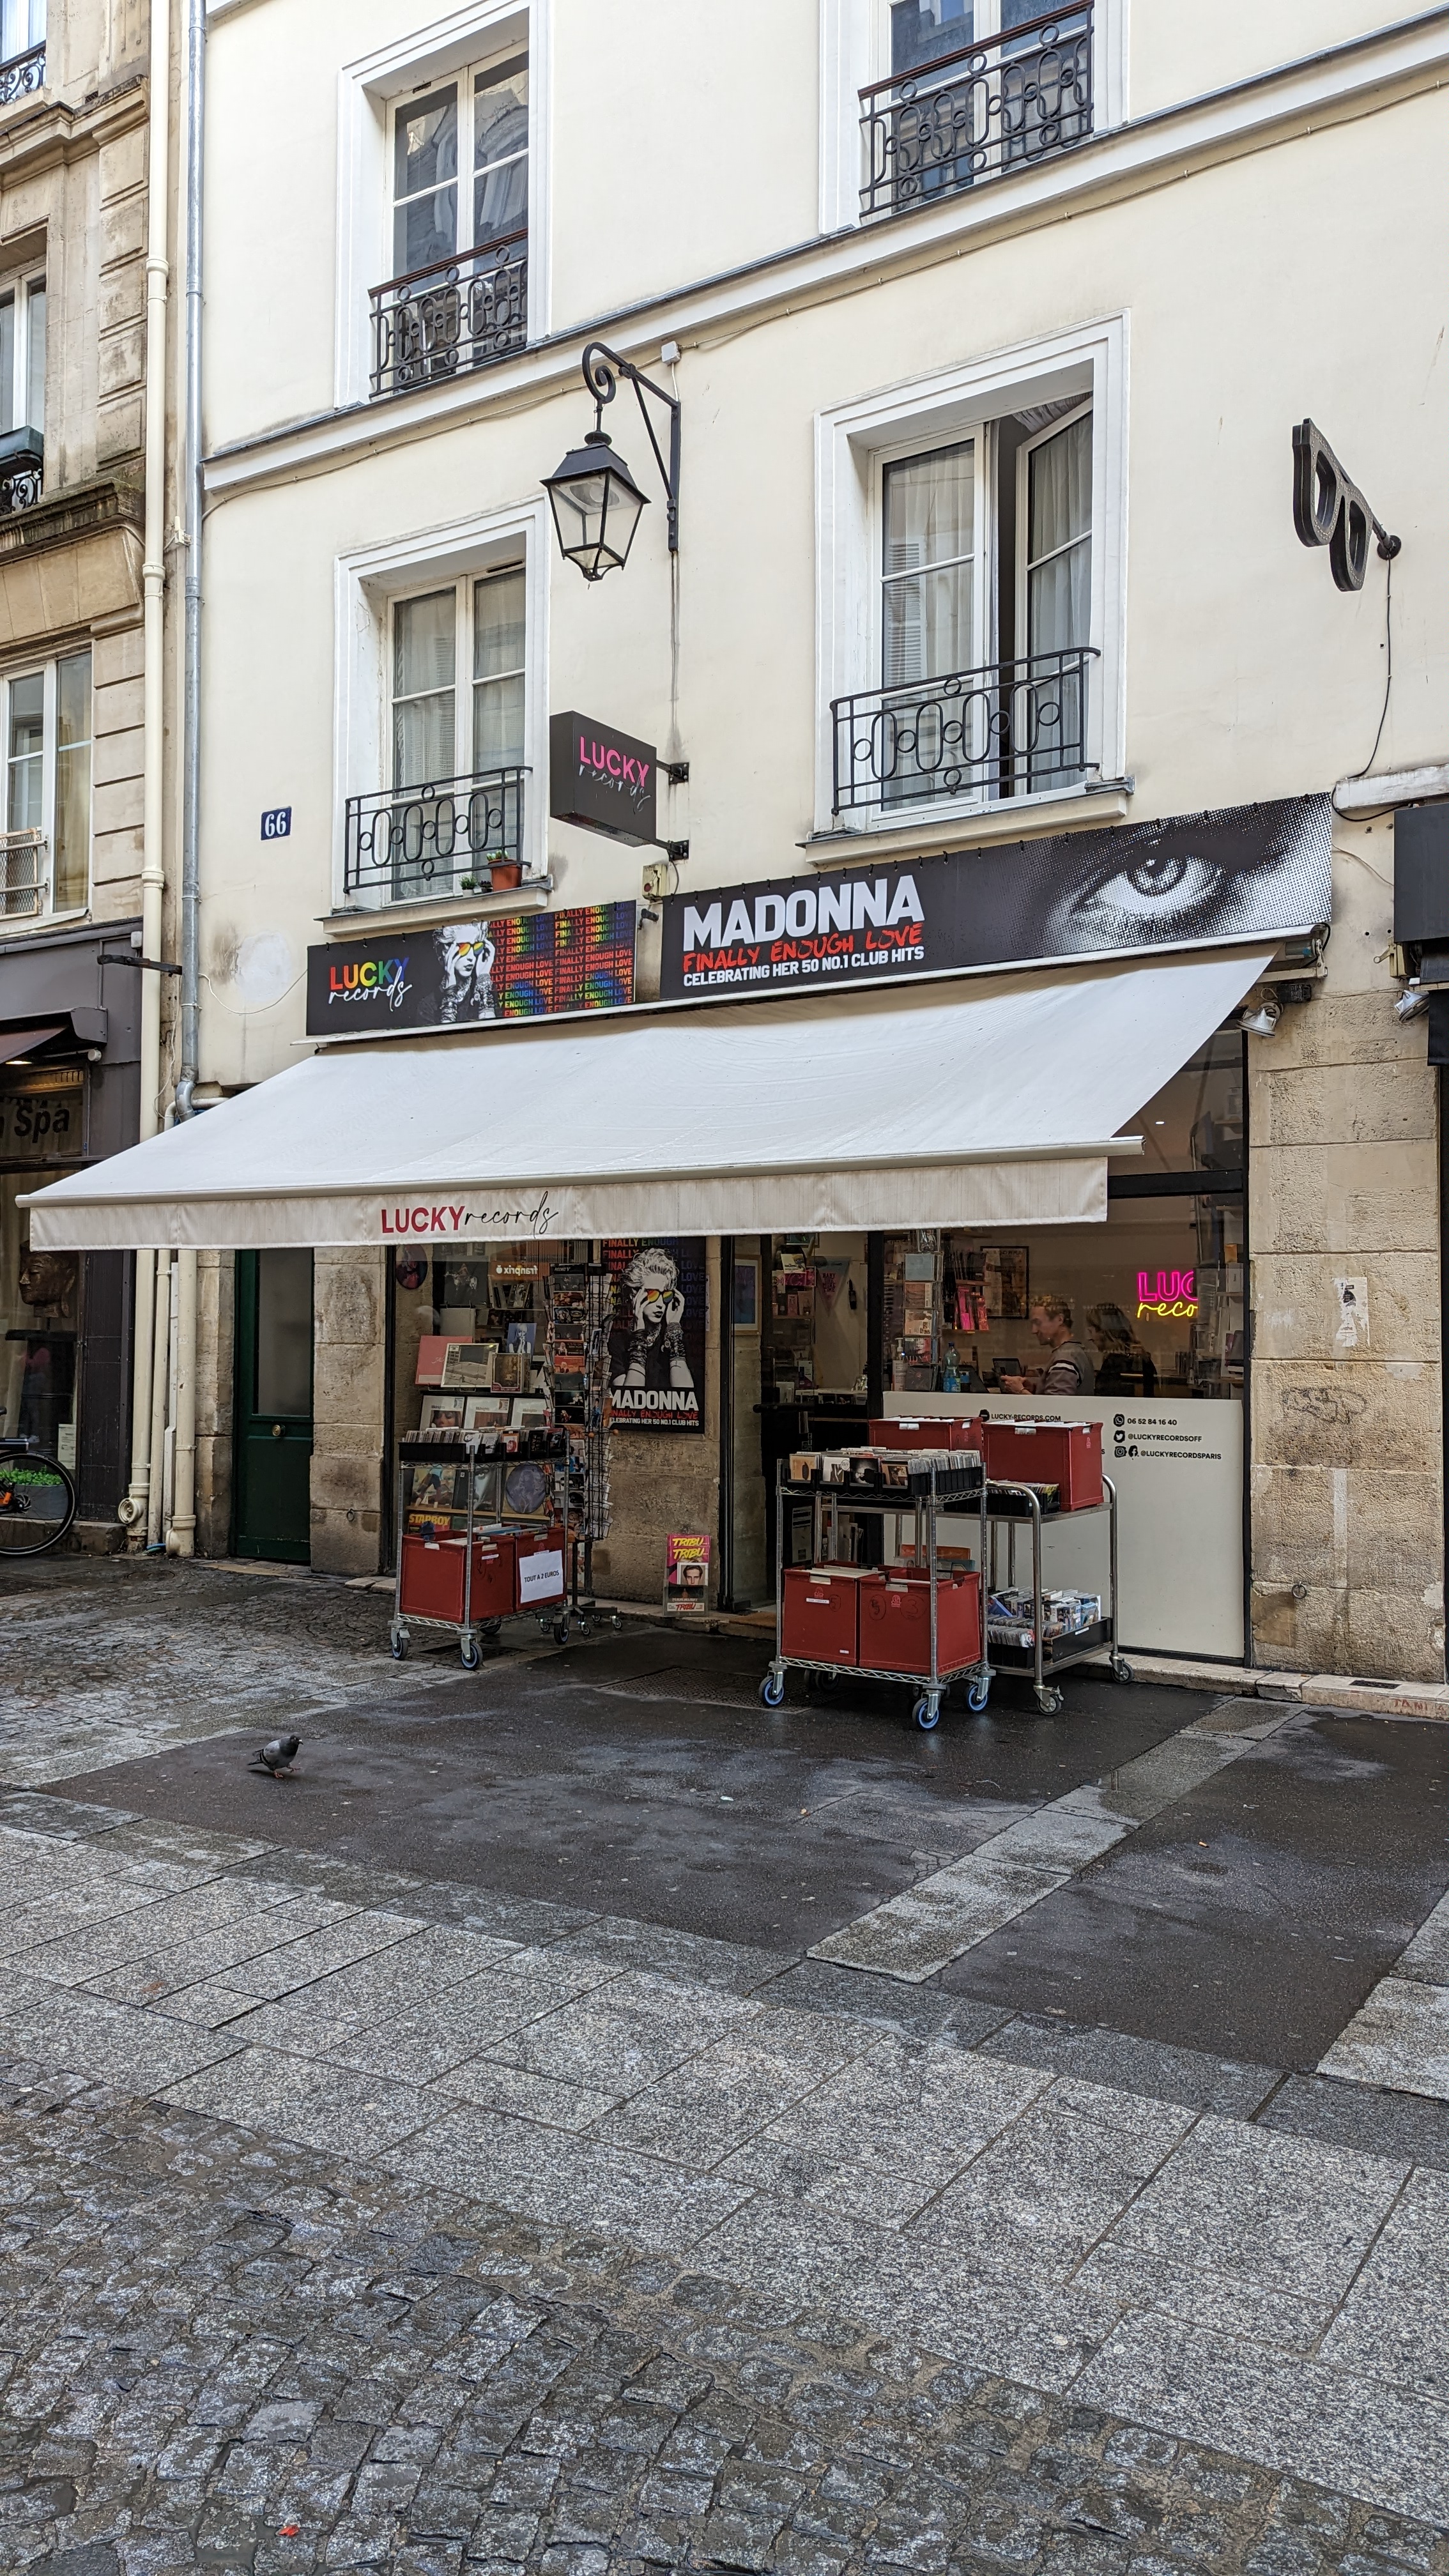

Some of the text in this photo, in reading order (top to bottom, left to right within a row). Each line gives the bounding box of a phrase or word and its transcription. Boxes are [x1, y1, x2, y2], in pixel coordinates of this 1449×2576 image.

[579, 736, 649, 786] LUCKY
[579, 764, 651, 812] records
[265, 811, 286, 836] 66
[536, 913, 553, 922] LOVE
[536, 923, 553, 931] LOVE
[555, 918, 583, 929] FINALLY
[683, 875, 925, 952] MADONNA
[506, 935, 534, 944] ENOUGH
[536, 931, 553, 940] LOVE
[555, 927, 583, 939] FINALLY
[585, 923, 614, 934] ENOUGH
[616, 921, 633, 930] LOVE
[506, 944, 534, 954] ENOUGH
[536, 940, 553, 950] LOVE
[555, 937, 583, 947] FINALLY
[585, 932, 614, 944] ENOUGH
[616, 930, 633, 939] LOVE
[506, 953, 534, 963] ENOUGH
[536, 949, 553, 959] LOVE
[555, 946, 583, 957] FINALLY
[585, 942, 614, 953] ENOUGH
[616, 939, 633, 948] LOVE
[683, 922, 923, 973] FINALLY ENOUGH LOVE
[506, 962, 534, 972] ENOUGH
[536, 960, 553, 969] LOVE
[555, 955, 583, 966] FINALLY
[585, 951, 614, 962] ENOUGH
[615, 949, 632, 958] LOVE
[506, 970, 533, 981] ENOUGH
[536, 969, 553, 978] LOVE
[555, 965, 583, 976] FINALLY
[585, 960, 613, 972] ENOUGH
[615, 958, 632, 967] LOVE
[684, 946, 924, 986] CELEBRATING HER 50 NO.1 CLUB HITS
[330, 957, 410, 990] LUCKY
[505, 980, 533, 990] ENOUGH
[535, 978, 553, 986] LOVE
[555, 974, 583, 985] FINALLY
[585, 970, 613, 981] ENOUGH
[615, 967, 632, 977] LOVE
[328, 967, 412, 1011] records
[505, 989, 533, 999] ENOUGH
[535, 987, 553, 996] LOVE
[555, 983, 583, 993] FINALLY
[585, 979, 613, 990] ENOUGH
[615, 977, 632, 986] LOVE
[505, 998, 533, 1008] ENOUGH
[535, 996, 553, 1005] LOVE
[555, 993, 583, 1002] FINALLY
[585, 989, 613, 999] ENOUGH
[615, 986, 632, 995] LOVE
[505, 1008, 533, 1016] ENOUGH
[535, 1006, 553, 1014] LOVE
[585, 999, 613, 1008] ENOUGH
[615, 996, 632, 1004] LOVE
[14, 1105, 70, 1143] Spa
[381, 1191, 558, 1239] LUCKY records
[602, 1238, 679, 1247] FINALLY ENOUGH
[1138, 1271, 1199, 1301] LUC
[1137, 1301, 1199, 1318] reco
[610, 1389, 699, 1411] MADONNA
[640, 1409, 673, 1419] ENOUGH
[677, 1411, 698, 1420] LOVE
[991, 1413, 1061, 1422] LUCKY-RECORDS.COM
[1128, 1433, 1202, 1442] @LUCKYRECORDSOFF
[1140, 1450, 1222, 1460] @LUCKYRECORDSPARIS
[409, 1514, 451, 1526] STARBOY
[672, 1537, 703, 1546] TRIBU
[673, 1547, 705, 1560] TRIBU
[544, 1570, 560, 1578] EUROS
